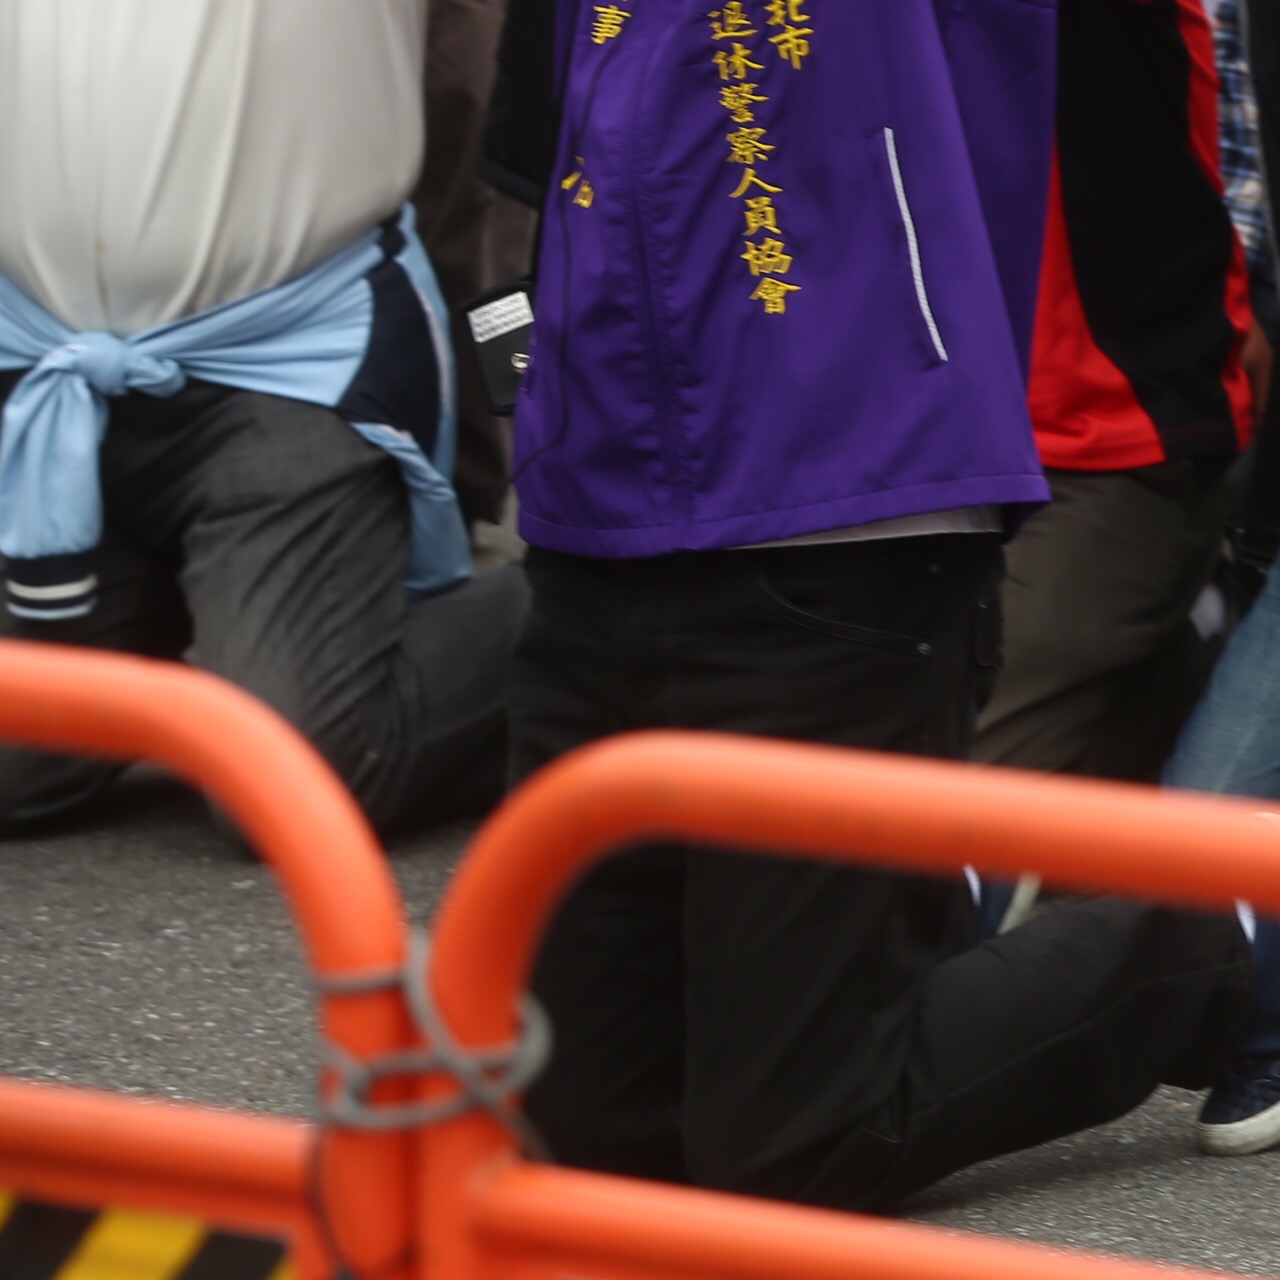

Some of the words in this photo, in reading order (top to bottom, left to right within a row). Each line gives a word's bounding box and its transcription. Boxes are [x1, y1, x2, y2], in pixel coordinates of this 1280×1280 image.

[708, 0, 802, 316] 退休警察人員協會
